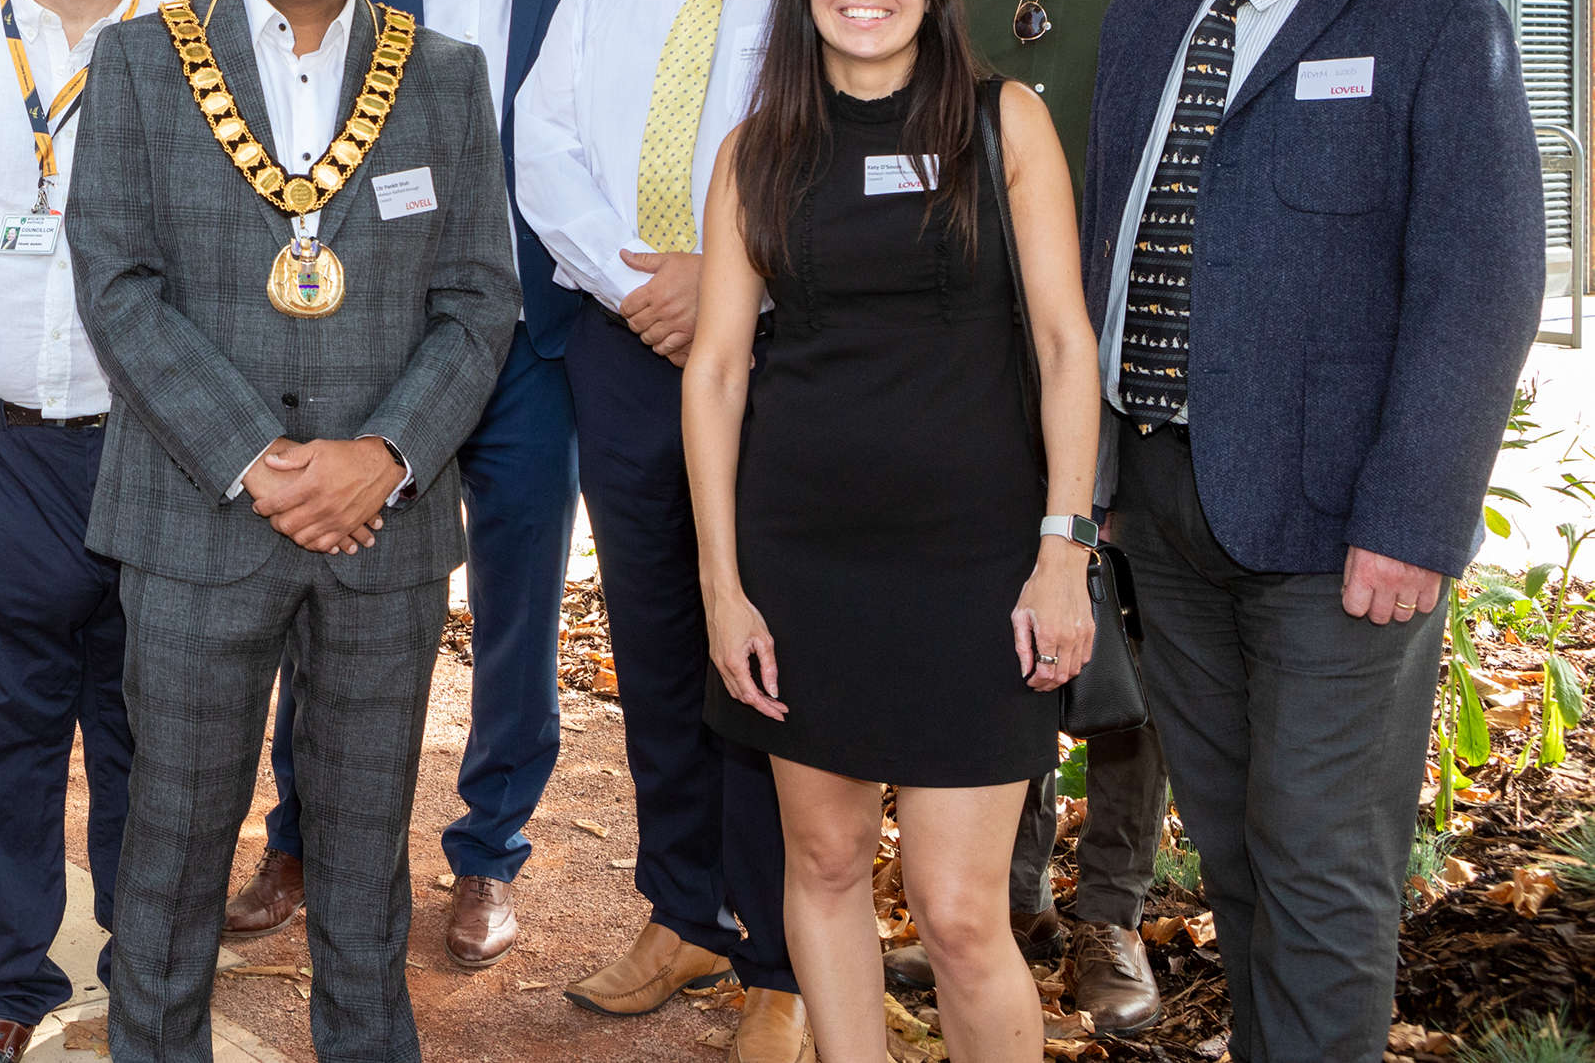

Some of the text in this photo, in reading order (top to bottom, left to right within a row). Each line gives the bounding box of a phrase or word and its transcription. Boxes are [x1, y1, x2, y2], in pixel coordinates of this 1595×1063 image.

[1300, 67, 1357, 79] ADAM WOOD
[1330, 85, 1366, 95] LOVELL
[405, 198, 432, 210] LOVELL
